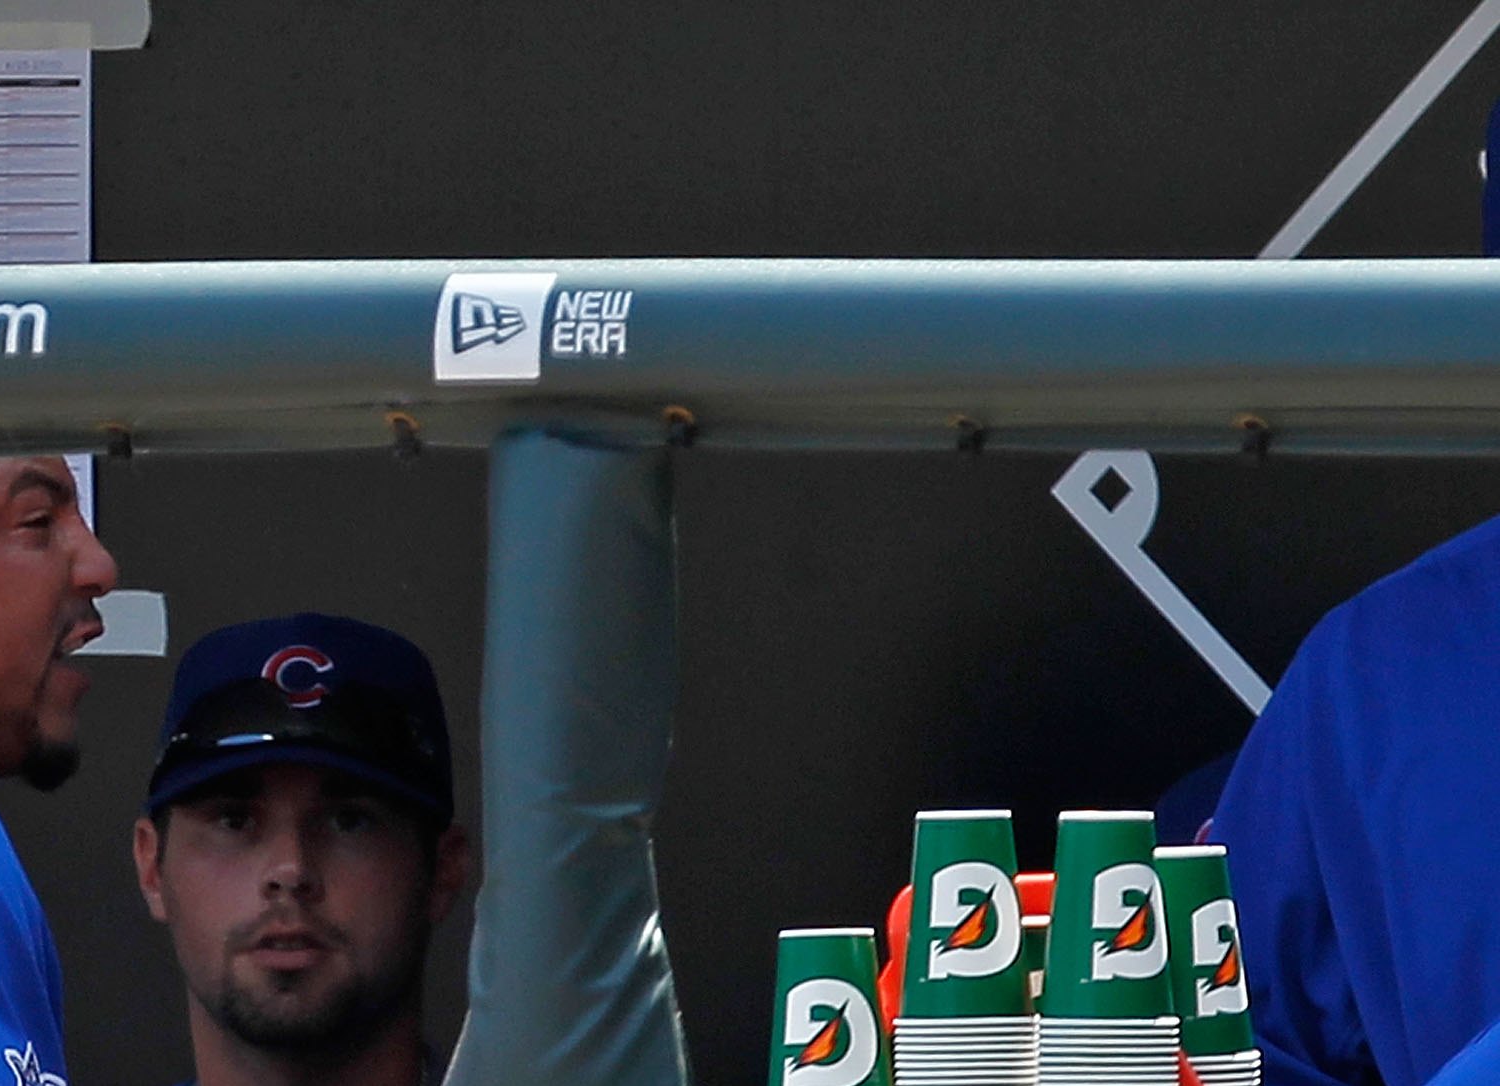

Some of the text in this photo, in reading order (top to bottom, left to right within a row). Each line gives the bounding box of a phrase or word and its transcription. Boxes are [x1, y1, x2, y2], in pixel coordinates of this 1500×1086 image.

[555, 290, 633, 320] NEW
[552, 322, 627, 354] ERA
[261, 645, 334, 708] C
